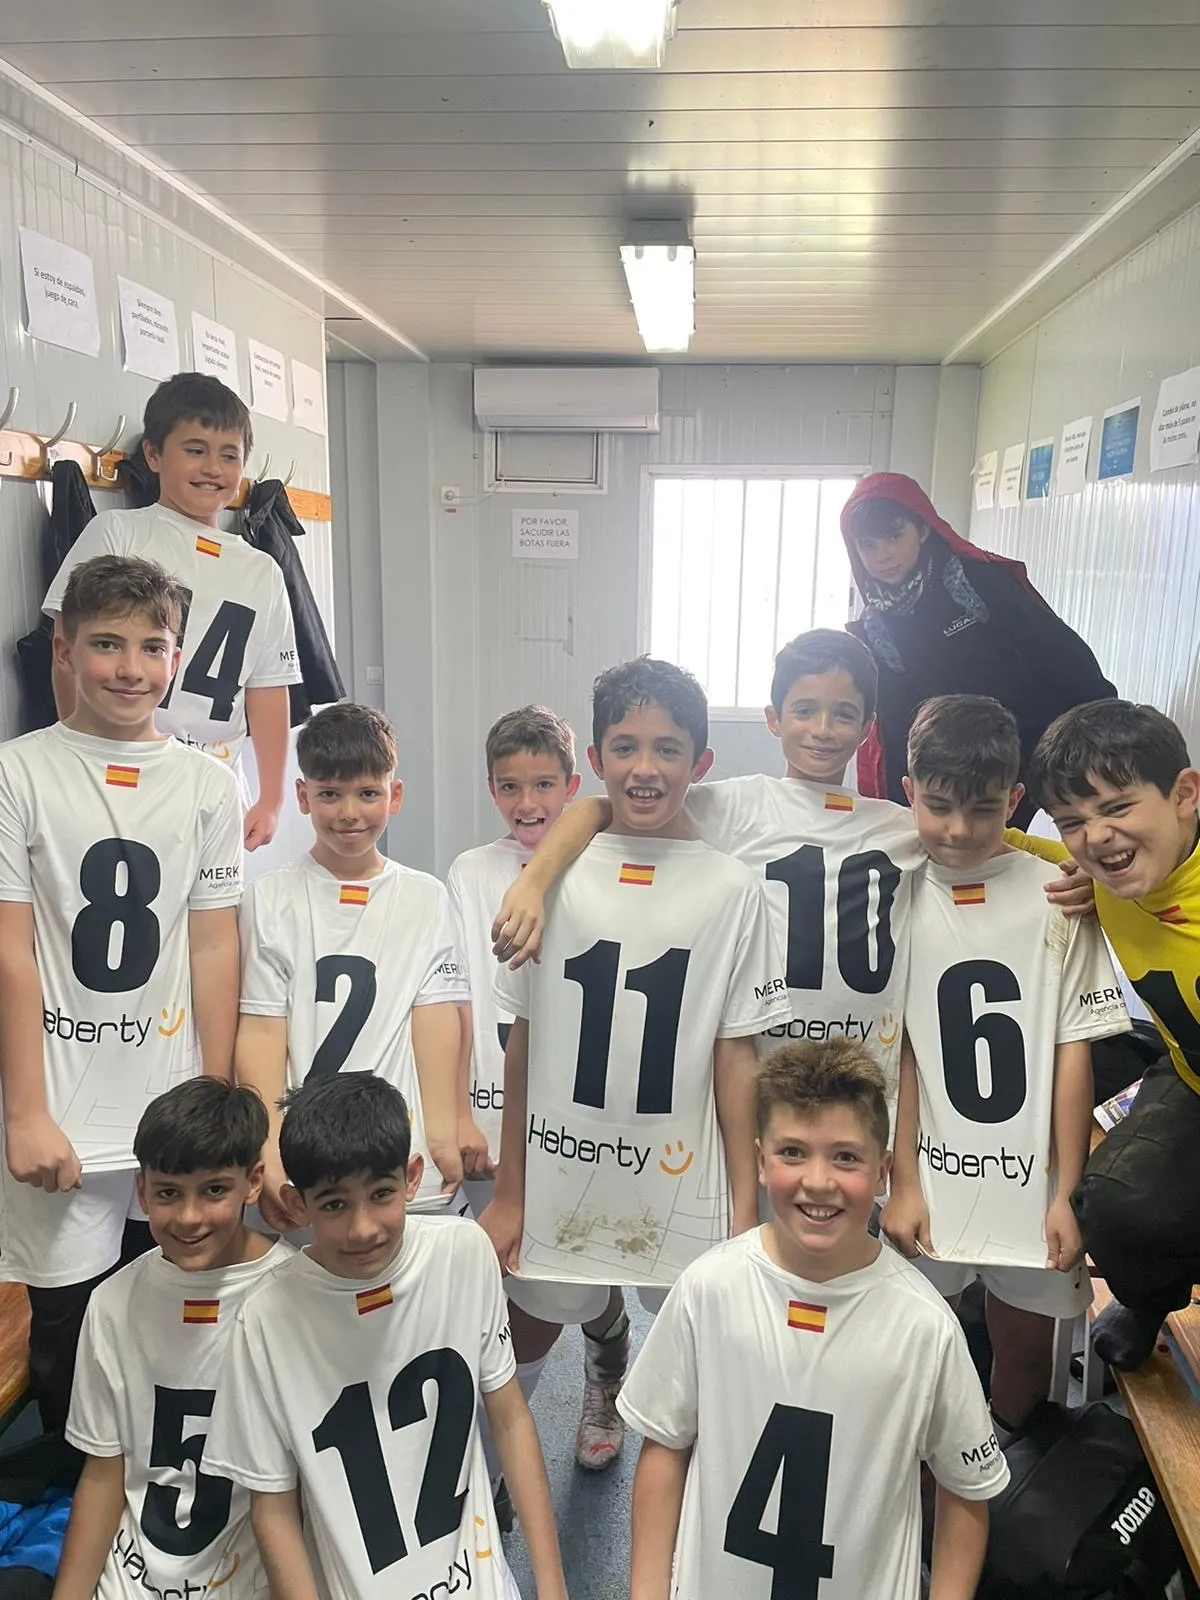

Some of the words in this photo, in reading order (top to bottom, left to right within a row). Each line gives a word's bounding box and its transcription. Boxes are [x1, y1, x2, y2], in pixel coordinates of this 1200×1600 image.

[40, 271, 56, 285] estoy
[56, 276, 63, 287] de
[519, 528, 554, 537] SACUDIR
[556, 528, 570, 537] LAS
[519, 539, 545, 548] BOTAS
[546, 539, 571, 548] FUERA
[520, 517, 537, 526] POR
[71, 838, 161, 993] 8
[200, 865, 240, 881] MERK
[766, 844, 903, 994] 10
[303, 954, 377, 1085] 2
[564, 939, 692, 1115] 11
[937, 959, 1027, 1124] 6
[528, 1113, 651, 1175] Heberty
[918, 1132, 1034, 1187] Heberty
[140, 1384, 234, 1556] 5
[311, 1347, 475, 1575] 12
[724, 1402, 835, 1600] 4
[1111, 1486, 1156, 1545] Joma
